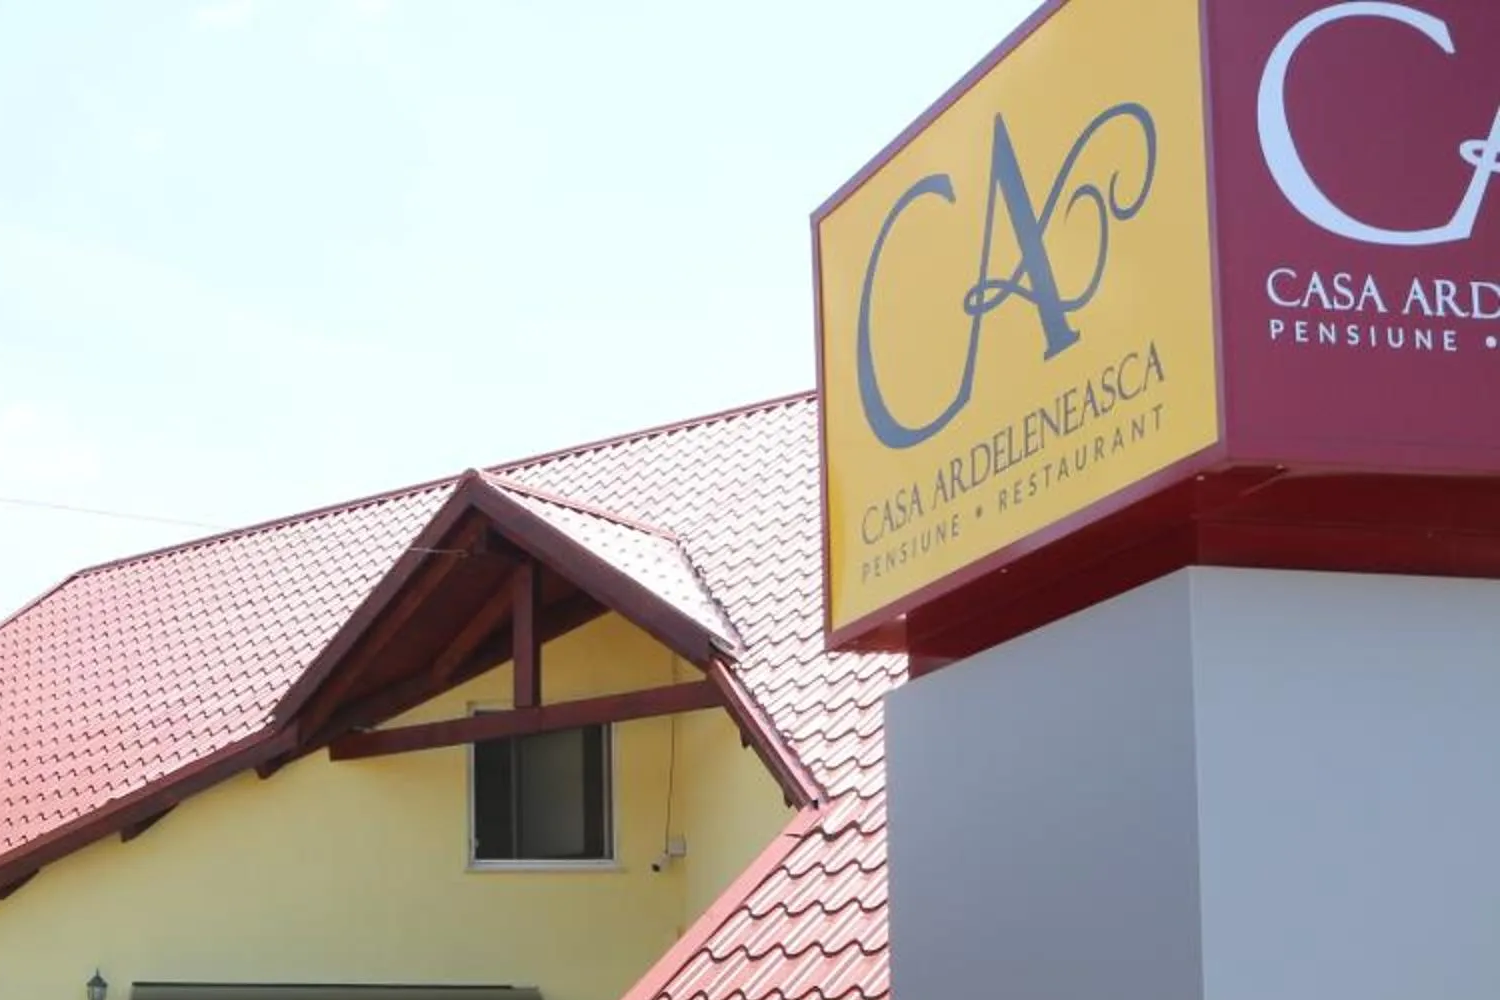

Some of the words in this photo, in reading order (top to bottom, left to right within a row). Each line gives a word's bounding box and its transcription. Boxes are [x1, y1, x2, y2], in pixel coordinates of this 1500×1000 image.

[1257, 0, 1500, 245] C
[856, 102, 1157, 450] CA
[1266, 267, 1388, 313] CASA
[1269, 318, 1459, 352] PENSIUNE
[861, 482, 925, 546] CASA
[931, 340, 1166, 512] ARDELENEASCA
[861, 514, 961, 584] PENSIUNE
[998, 403, 1164, 514] RESTAURANT
